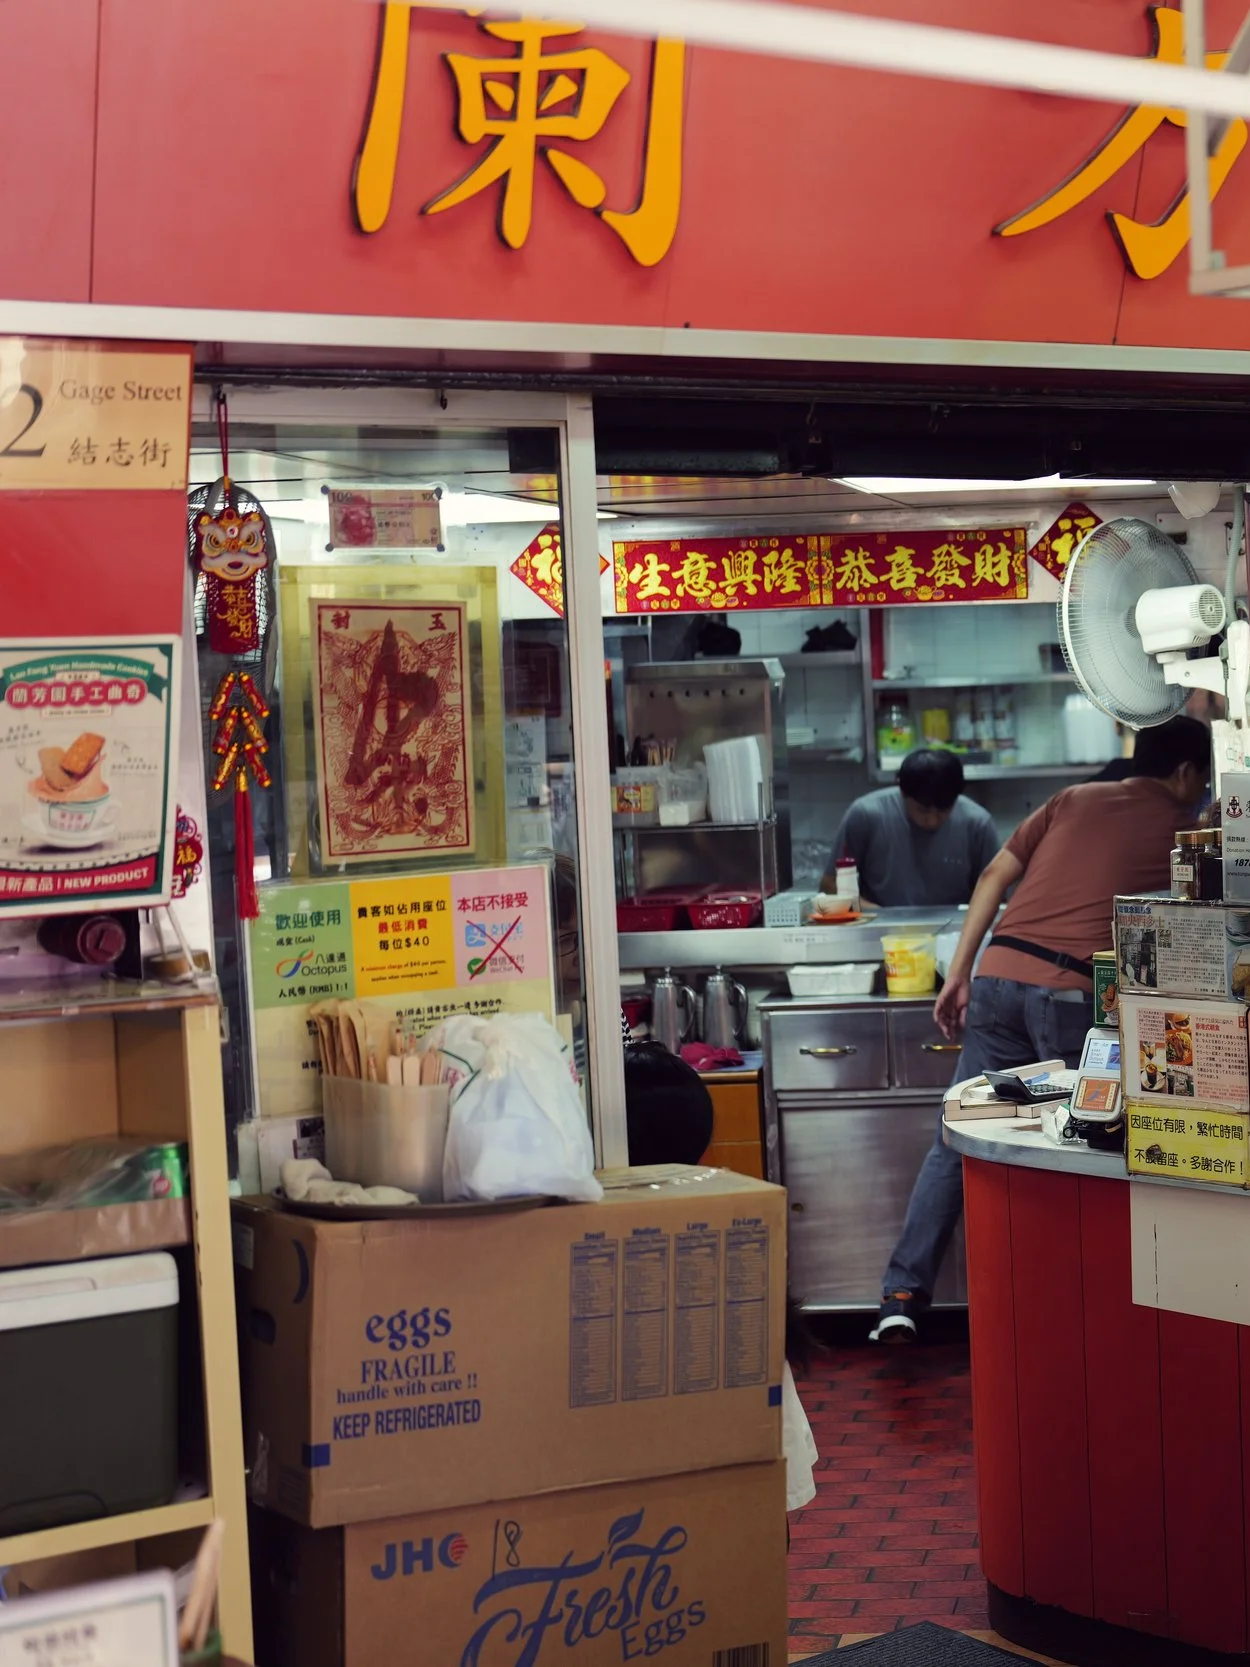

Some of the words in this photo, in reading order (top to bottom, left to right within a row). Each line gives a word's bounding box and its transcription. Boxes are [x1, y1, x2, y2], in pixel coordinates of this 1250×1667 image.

[60, 379, 116, 405] Gage
[123, 381, 182, 401] Street
[68, 437, 172, 468] 結志街
[628, 548, 806, 600] 生意興隆
[836, 542, 1014, 592] 恭喜發財
[64, 876, 90, 889] NEW
[94, 867, 149, 885] PRODUCT
[457, 891, 528, 912] 本店不接受
[276, 909, 341, 930] 歡迎使用
[378, 918, 428, 933] 最低消費
[301, 964, 347, 977] Octopus
[315, 952, 346, 965] 八達通
[364, 1307, 452, 1351] eggs
[360, 1351, 456, 1383] FRAGILE
[336, 1384, 389, 1405] handle
[394, 1379, 427, 1399] with
[430, 1375, 463, 1393] care
[332, 1411, 371, 1441] KEEP
[375, 1399, 481, 1437] REFRIGERATED
[460, 1524, 688, 1667] Fresh
[620, 1600, 707, 1662] Eggs
